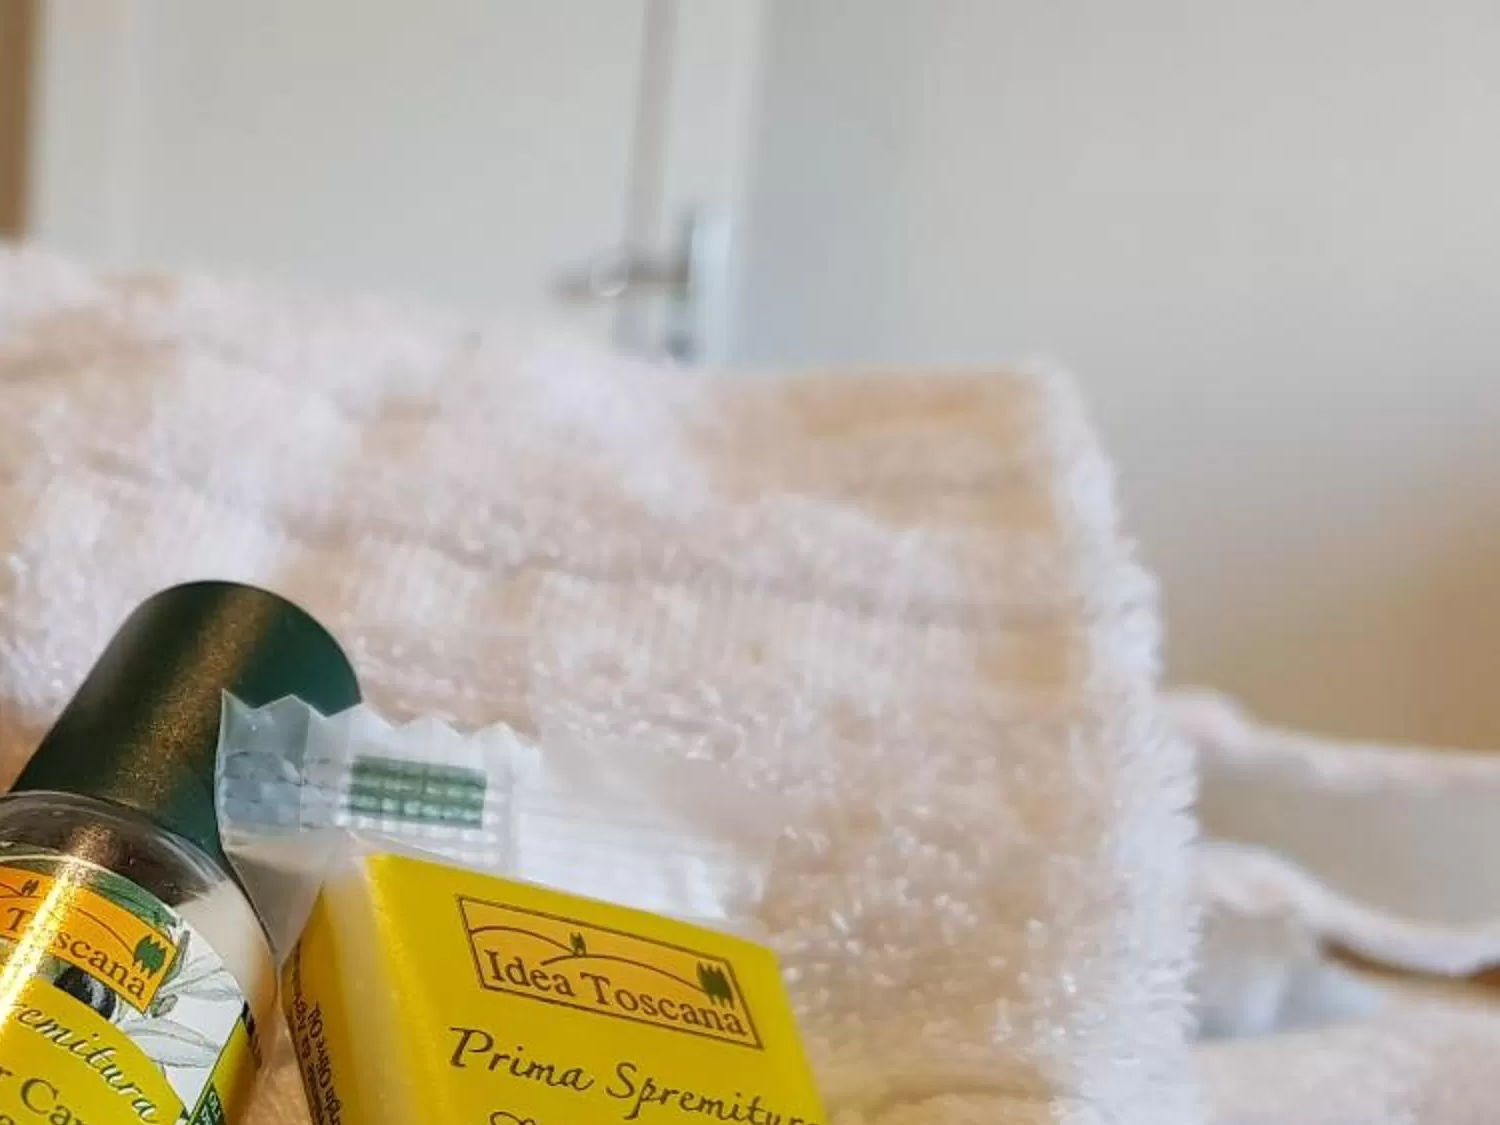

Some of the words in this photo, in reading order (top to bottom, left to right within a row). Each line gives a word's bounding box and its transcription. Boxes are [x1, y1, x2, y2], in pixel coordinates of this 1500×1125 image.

[6, 906, 149, 1001] Tscana
[483, 948, 576, 999] Idea
[579, 970, 750, 1038] Toscana
[448, 1025, 596, 1092] Prima
